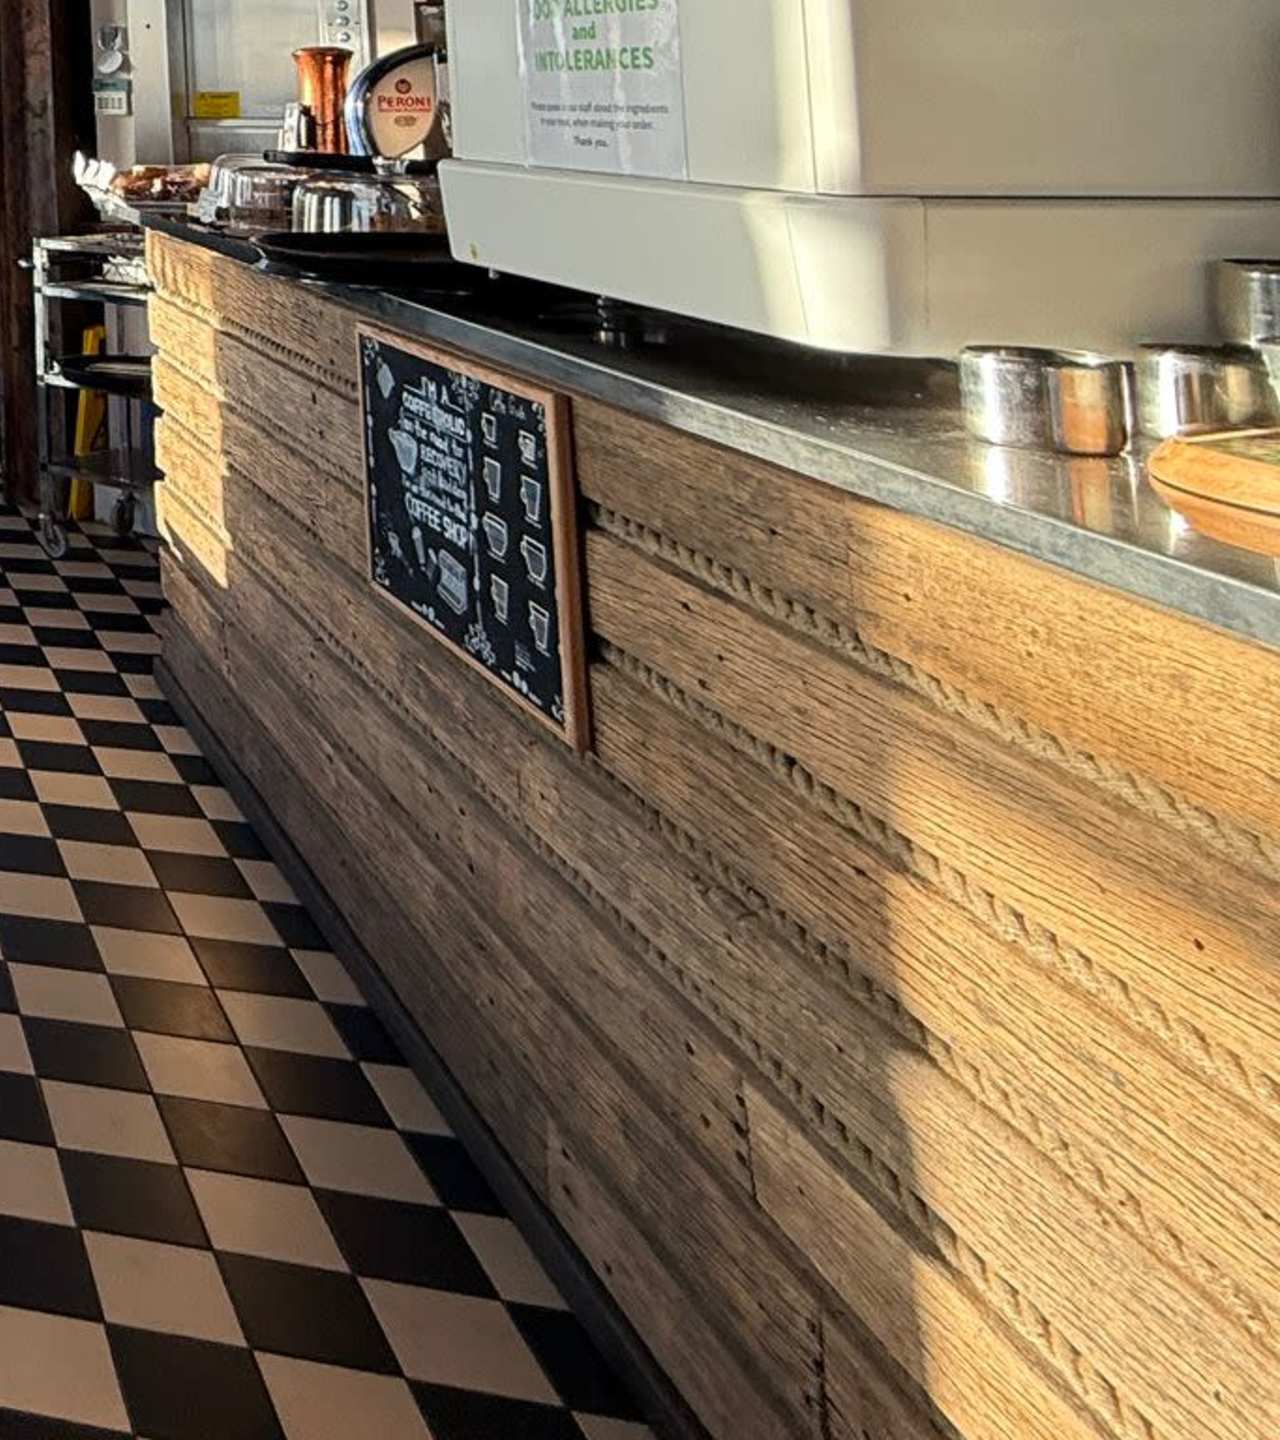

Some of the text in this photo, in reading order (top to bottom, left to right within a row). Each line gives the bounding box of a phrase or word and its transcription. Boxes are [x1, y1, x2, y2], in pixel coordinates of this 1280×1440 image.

[572, 21, 596, 40] and
[377, 96, 431, 108] PERONI
[404, 491, 441, 533] COFFEE
